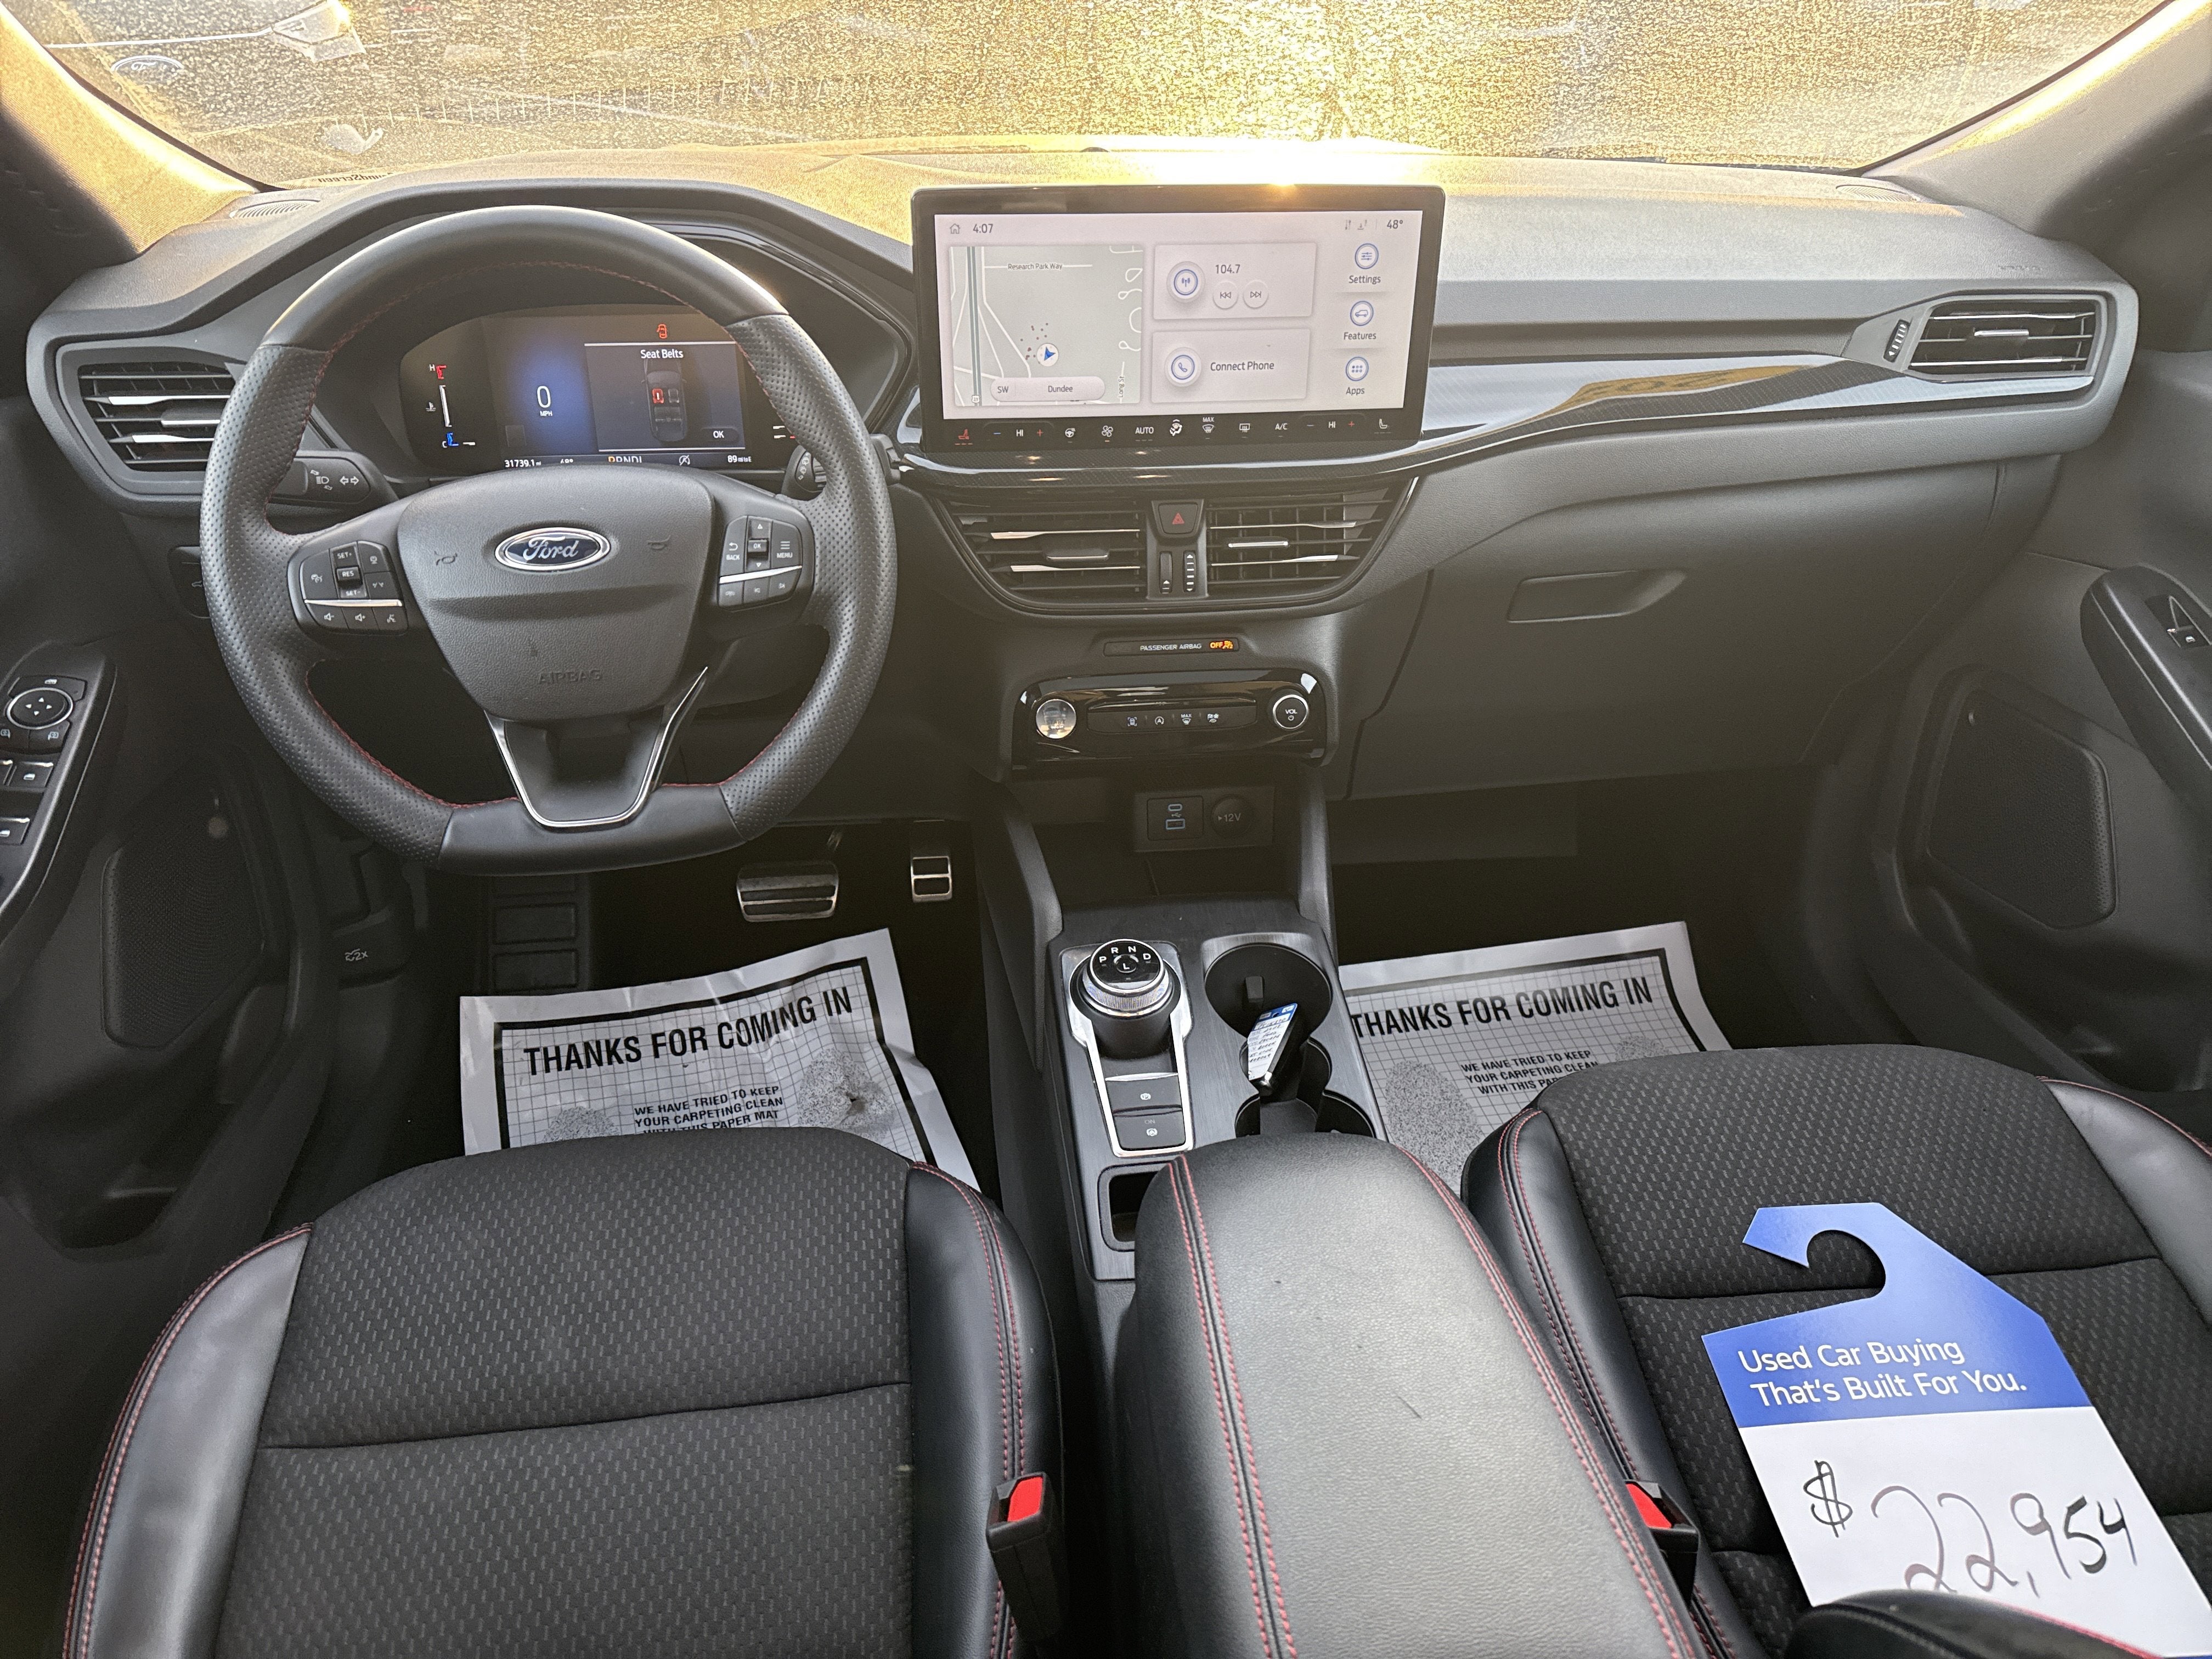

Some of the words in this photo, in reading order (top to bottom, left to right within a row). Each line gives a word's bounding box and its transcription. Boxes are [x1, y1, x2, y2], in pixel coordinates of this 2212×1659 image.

[973, 223, 994, 234] 4:07
[1386, 219, 1403, 229] 48°
[1215, 264, 1240, 274] 104.7
[1348, 275, 1381, 285] Settings
[1344, 332, 1376, 340] Features
[640, 349, 659, 358] Seat
[661, 349, 684, 358] Belts
[1210, 362, 1245, 371] Connect
[1247, 360, 1274, 370] Phone
[1048, 385, 1073, 393] Dundee
[1345, 387, 1365, 396] Apps
[537, 385, 551, 408] 0
[1274, 422, 1288, 431] A/C
[713, 430, 725, 438] OK
[504, 459, 535, 467] 31739.1
[522, 535, 580, 561] Ford
[1223, 812, 1241, 822] 12V
[1351, 1002, 1452, 1039] THANKS
[1457, 995, 1511, 1025] FOR
[1516, 981, 1620, 1018] COMING
[1623, 976, 1654, 1005] IN
[523, 1036, 642, 1076] THANKS
[651, 1026, 708, 1059] FOR
[718, 996, 817, 1049] COMING
[822, 986, 852, 1017] IN
[1460, 1063, 1481, 1073] WE
[1481, 1059, 1510, 1070] HAVE
[1511, 1055, 1545, 1067] TRIED
[1546, 1053, 1563, 1063] TO
[1564, 1050, 1592, 1060] KEEP
[1465, 1073, 1498, 1084] YOUR
[1500, 1065, 1562, 1081] CARPETING
[1477, 1084, 1510, 1094] WITH
[1510, 1080, 1537, 1092] THIS
[634, 1105, 654, 1115] WE
[658, 1101, 690, 1113] HAVE
[692, 1094, 729, 1107] TRIED
[731, 1088, 747, 1100] TO
[750, 1086, 780, 1096] KEEP
[635, 1116, 670, 1127] YOUR
[674, 1103, 742, 1124] CARPETING
[745, 1097, 783, 1110] CLEAN
[712, 1115, 751, 1129] PAPER
[753, 1110, 779, 1122] MAT
[1737, 1345, 1812, 1373] Used
[1817, 1344, 1860, 1367] Car
[1867, 1338, 1966, 1366] Buying
[1750, 1379, 1841, 1407] That's
[1843, 1373, 1912, 1400] Built
[1914, 1373, 1958, 1396] For
[1961, 1369, 2027, 1394] You.
[1803, 1459, 1853, 1538] $
[1871, 1485, 2137, 1598] 22,954
